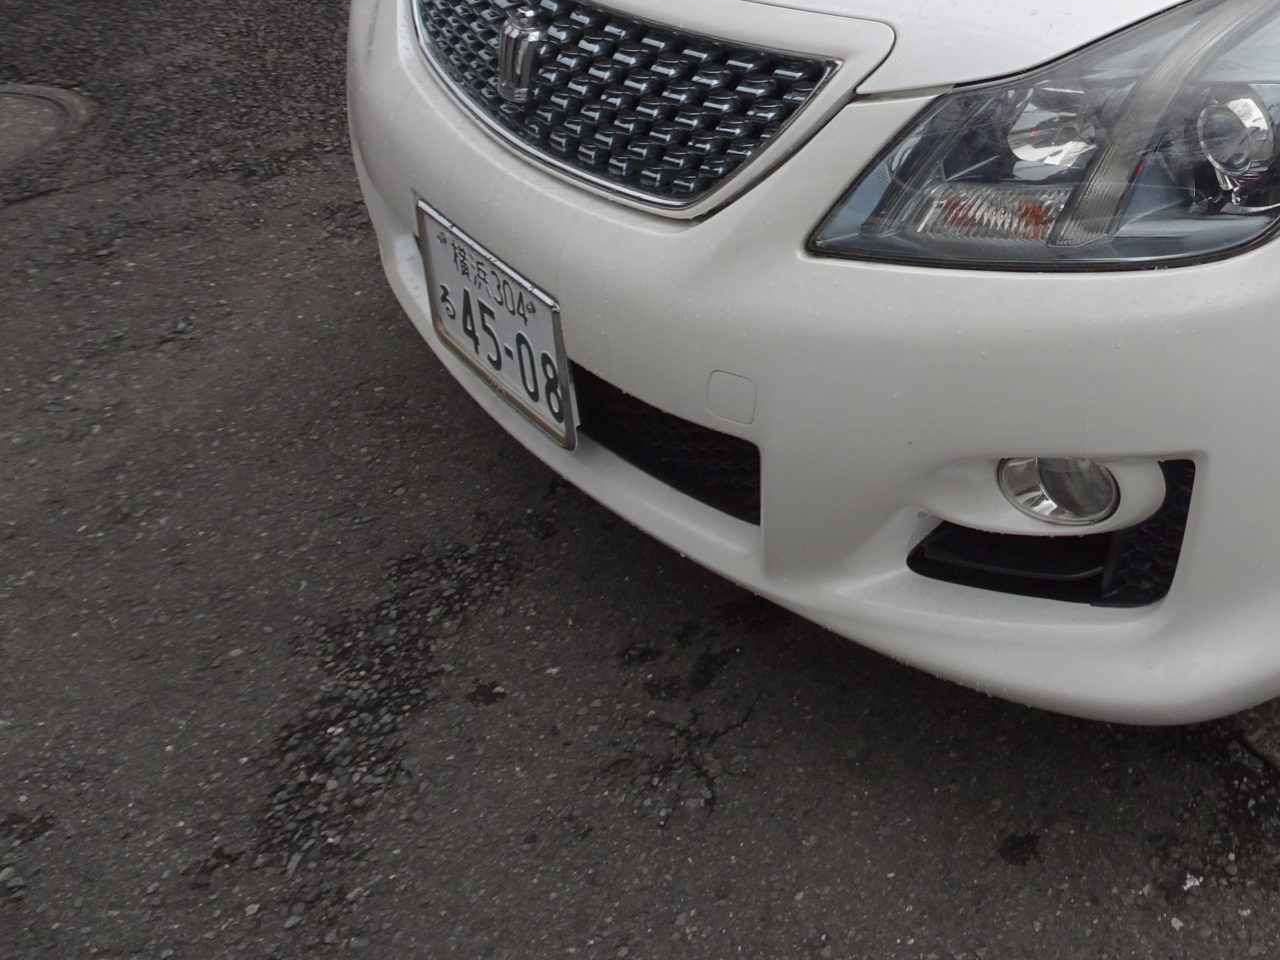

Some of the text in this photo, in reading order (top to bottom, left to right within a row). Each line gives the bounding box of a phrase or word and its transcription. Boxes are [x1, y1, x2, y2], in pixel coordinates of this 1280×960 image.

[451, 239, 529, 327] 横浜 304
[462, 287, 565, 424] 45-08
